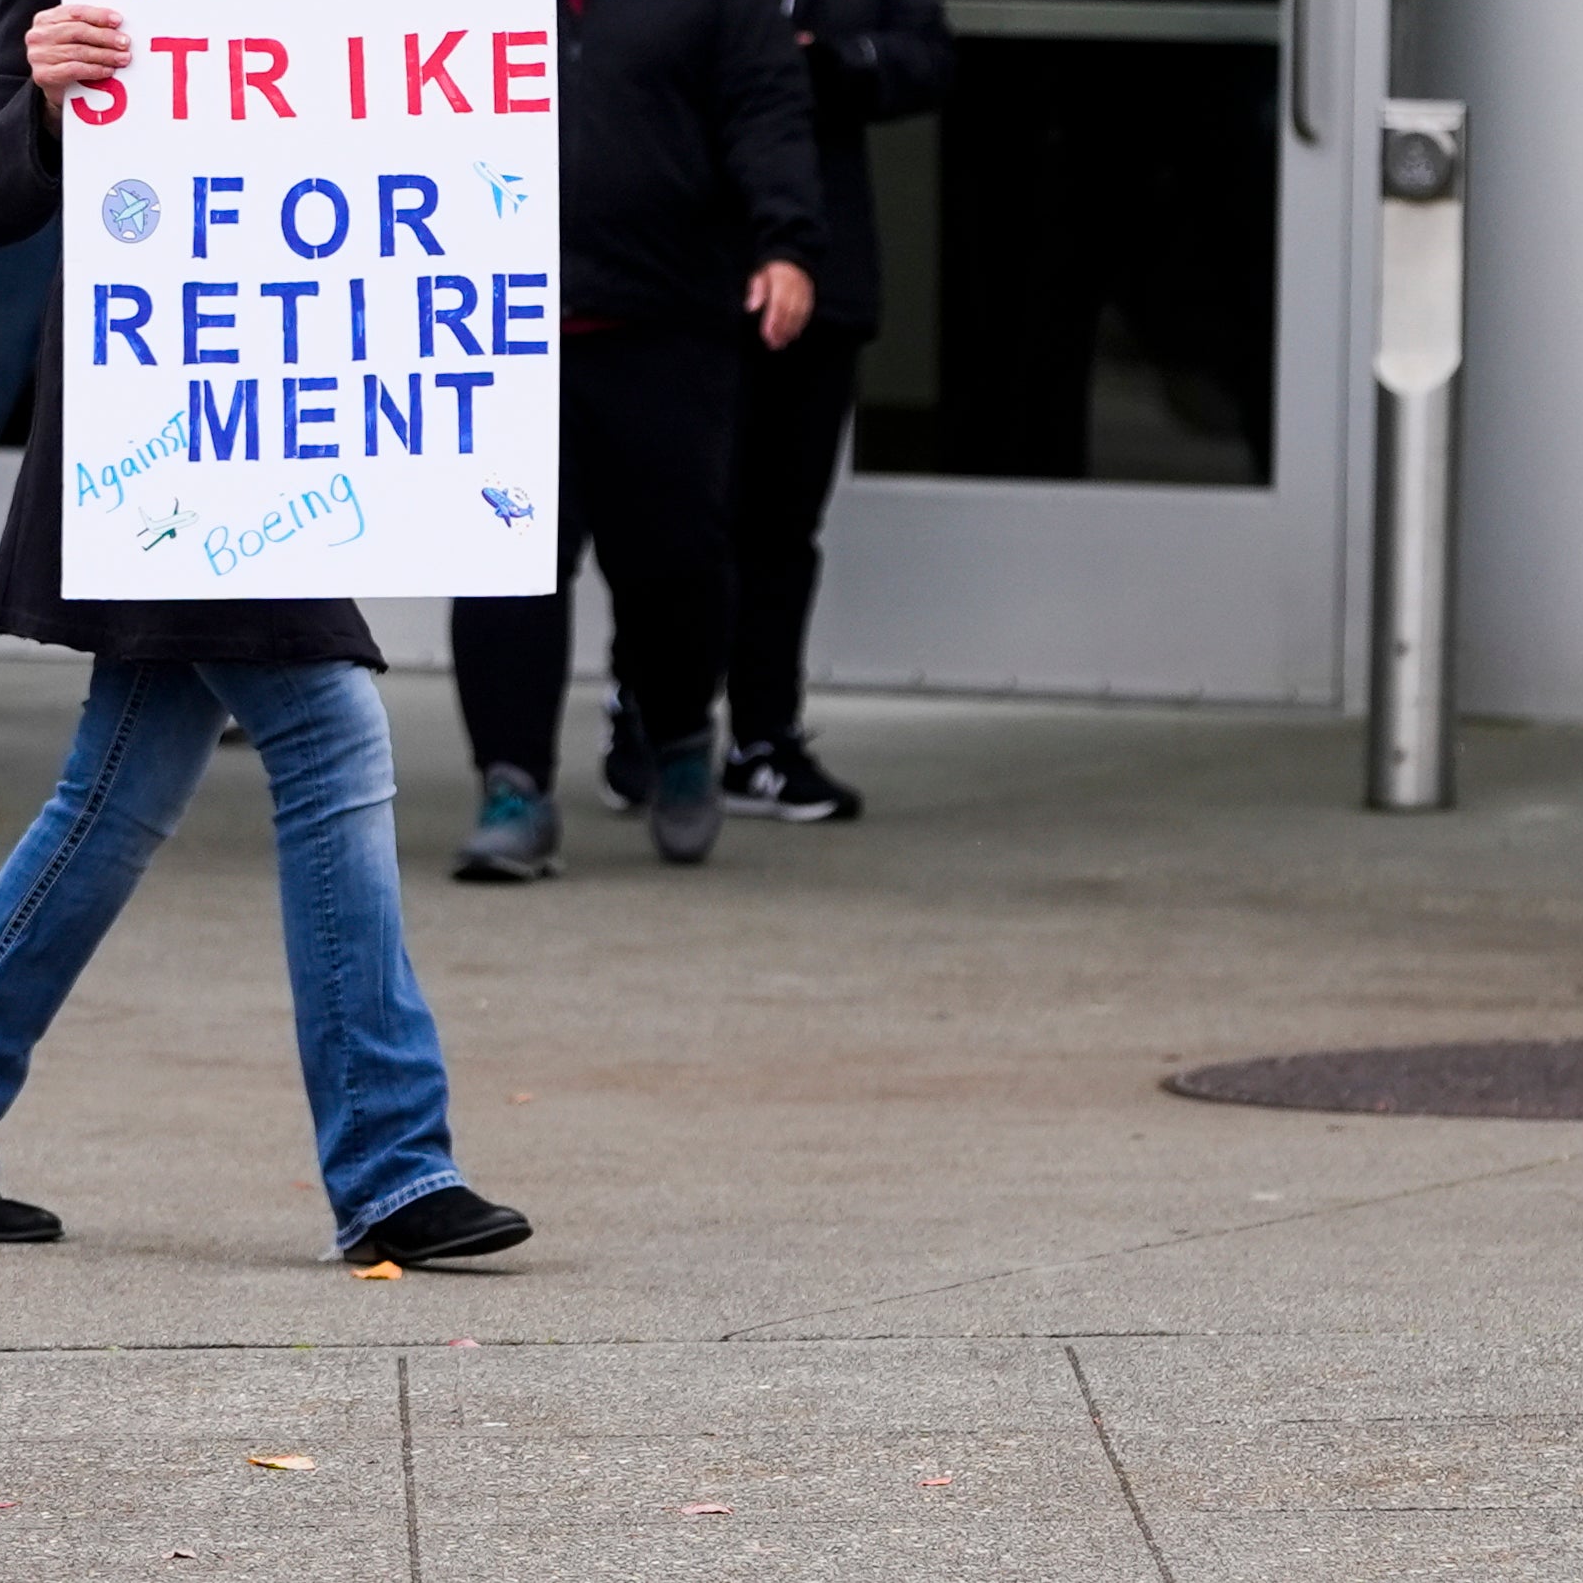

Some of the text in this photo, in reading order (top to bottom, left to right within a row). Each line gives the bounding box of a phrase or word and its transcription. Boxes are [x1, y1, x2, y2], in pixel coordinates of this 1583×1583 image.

[69, 30, 552, 125] STRIKE
[192, 173, 446, 259] FOR
[92, 273, 549, 367] RETIRE
[186, 371, 495, 463] MENT
[202, 472, 367, 578] Boeing
